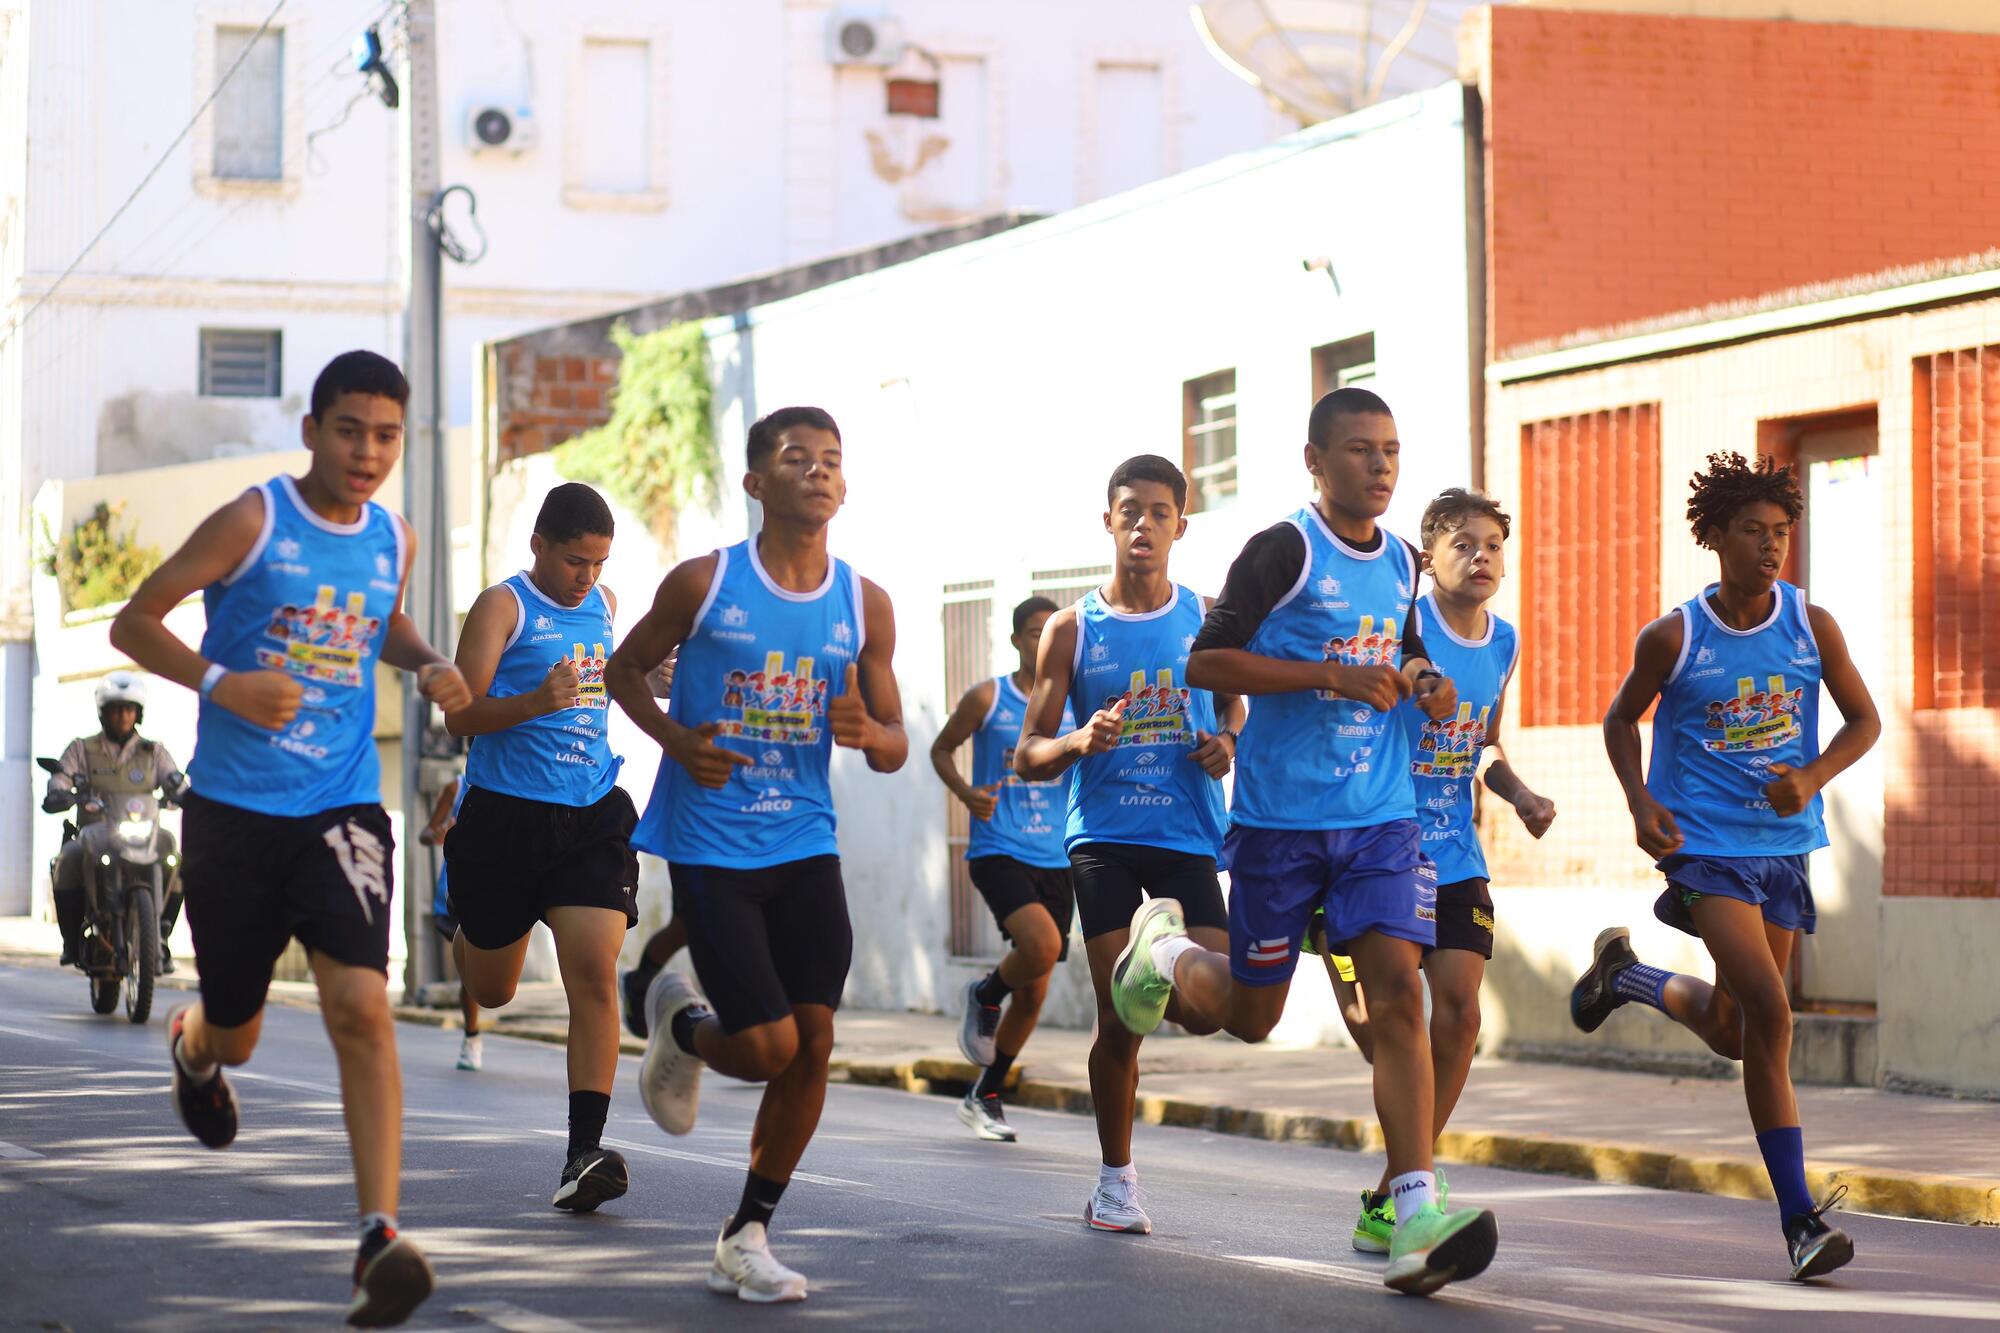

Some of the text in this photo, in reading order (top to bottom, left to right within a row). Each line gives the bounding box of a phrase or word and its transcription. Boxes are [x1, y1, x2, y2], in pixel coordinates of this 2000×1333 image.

[556, 752, 596, 767] LARCO
[1119, 795, 1174, 807] LARCO
[1393, 1179, 1427, 1199] FILA
